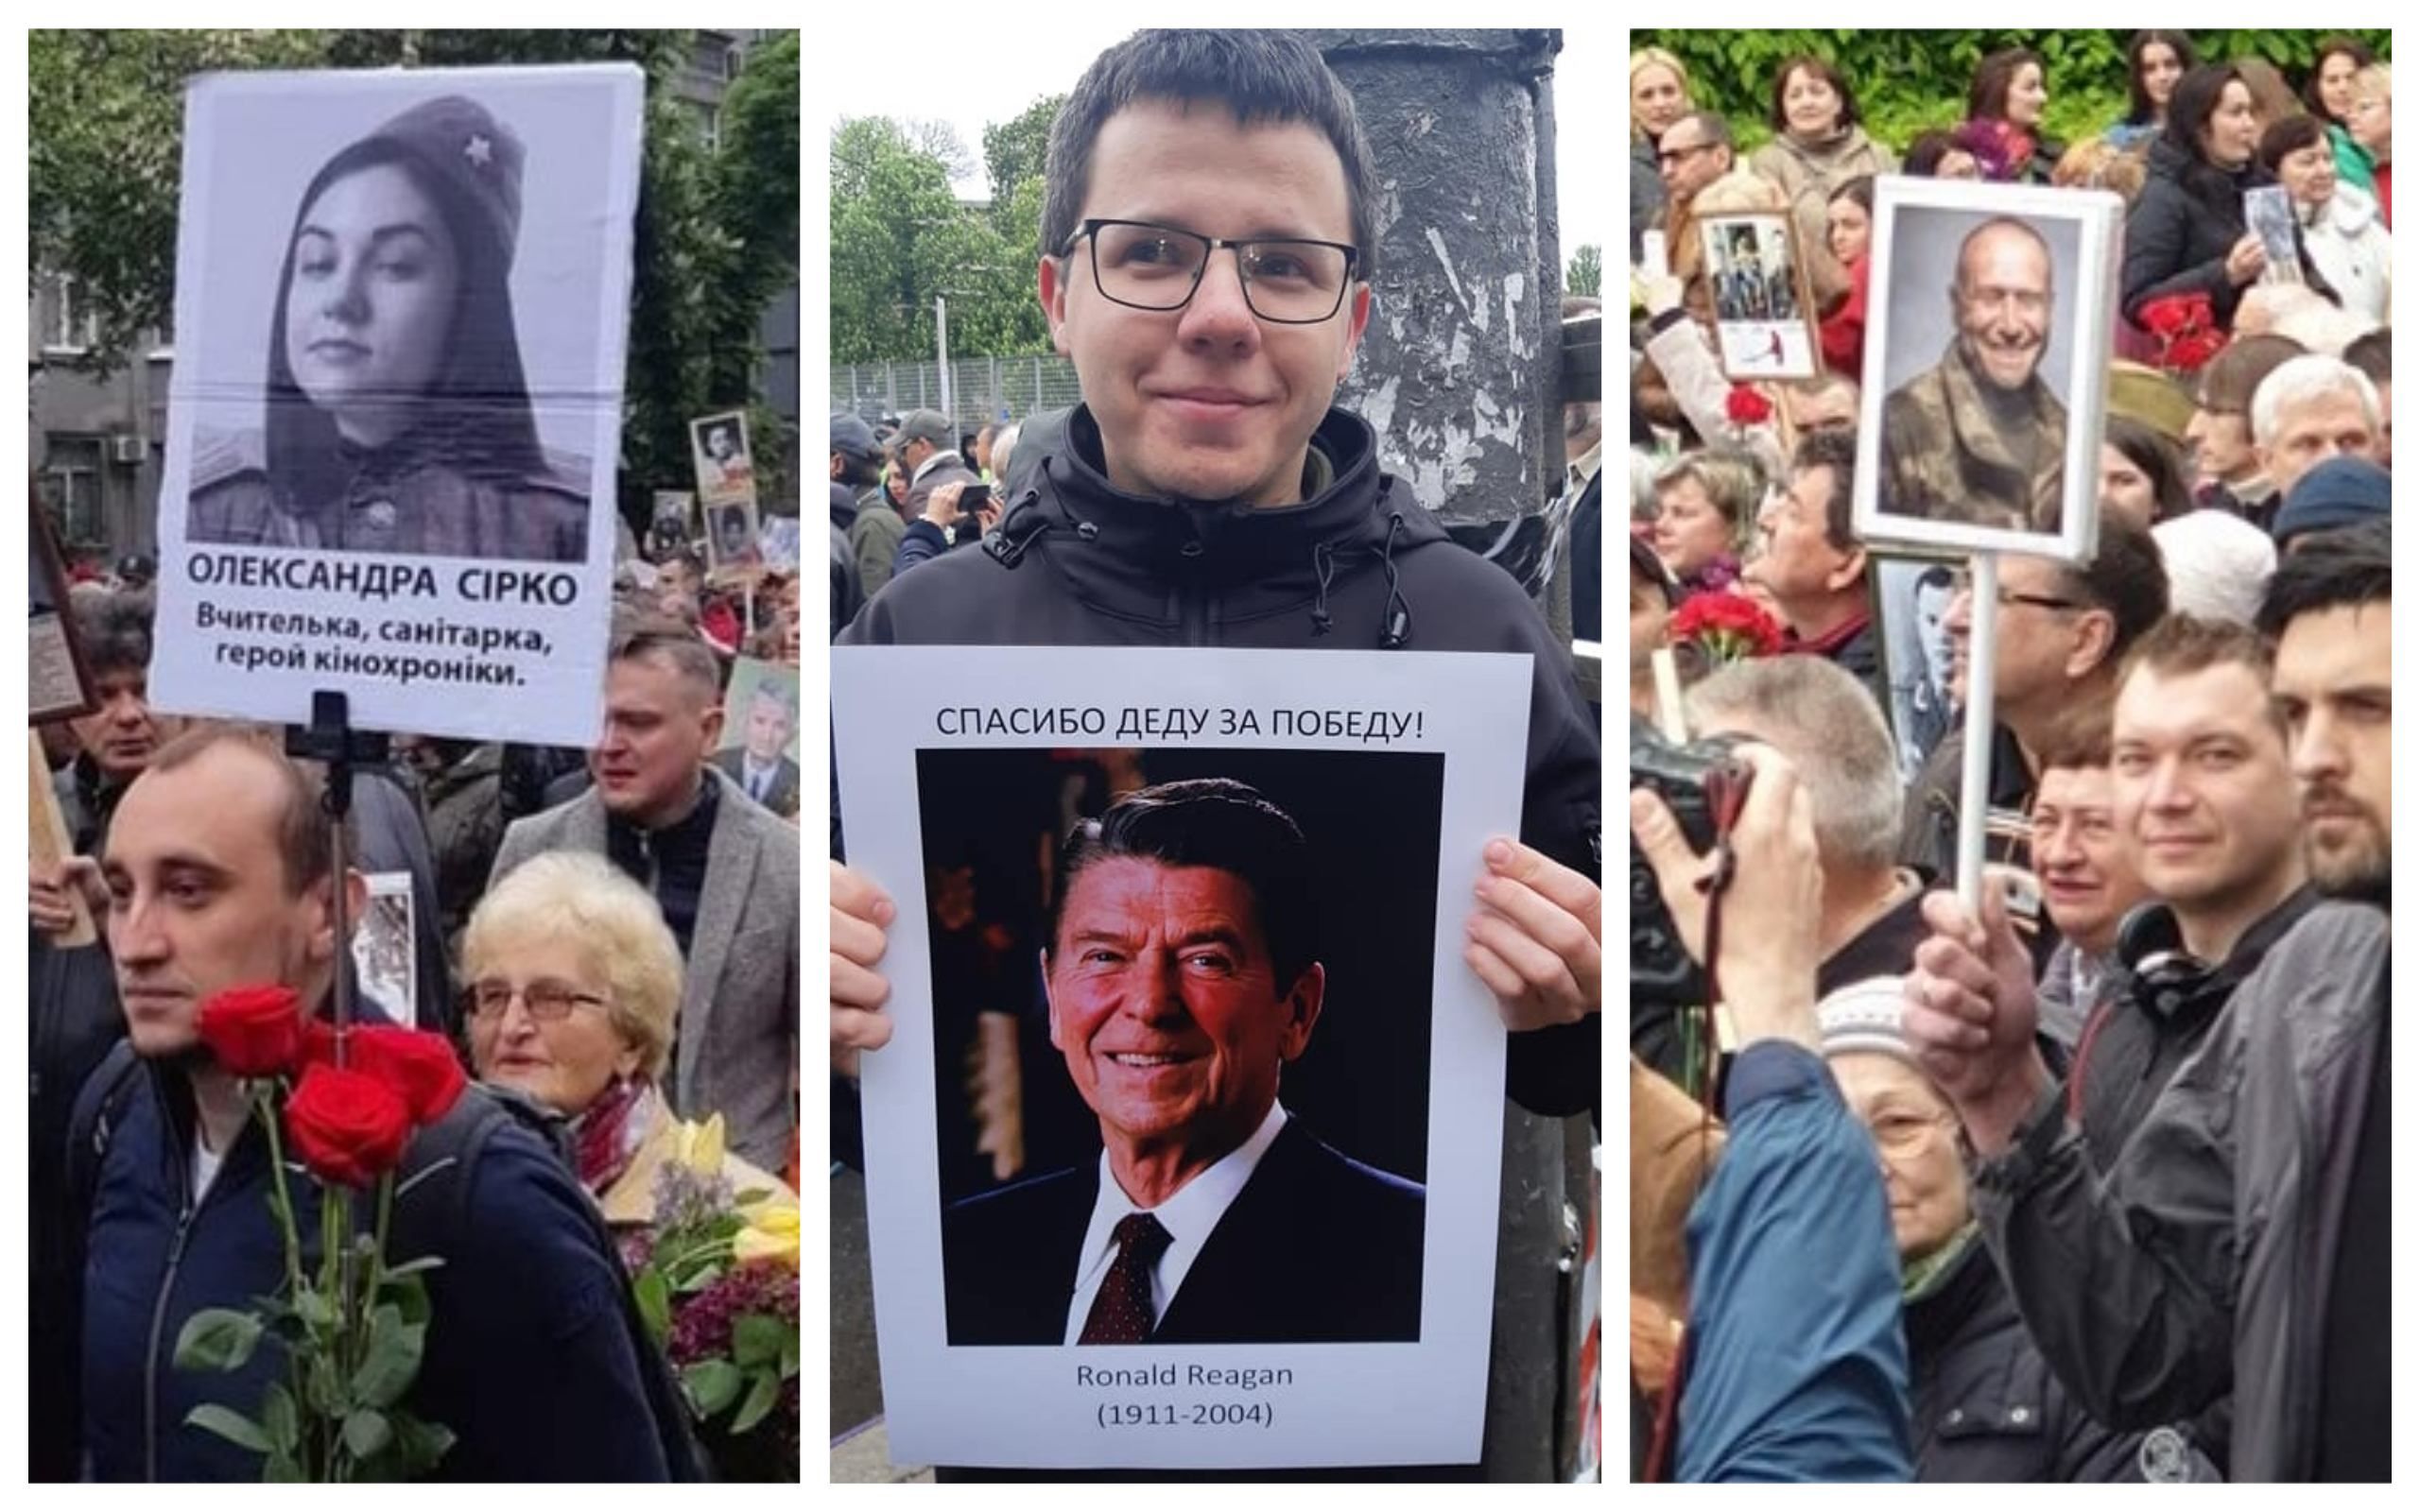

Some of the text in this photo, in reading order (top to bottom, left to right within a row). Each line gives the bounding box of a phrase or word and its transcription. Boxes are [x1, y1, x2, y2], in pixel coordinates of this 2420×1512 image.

[188, 552, 579, 606] ОЛЕКСАНДРА СІРКО
[196, 601, 553, 656] Вчителька, санітарка,
[216, 640, 527, 686] герой кінохроніки.
[936, 707, 1425, 744] СПАСИБО ДЕДУ ЗА ПОБЕДУ!
[1077, 1363, 1293, 1390] Ronald Reagan
[1098, 1402, 1273, 1428] (1911-2004)
